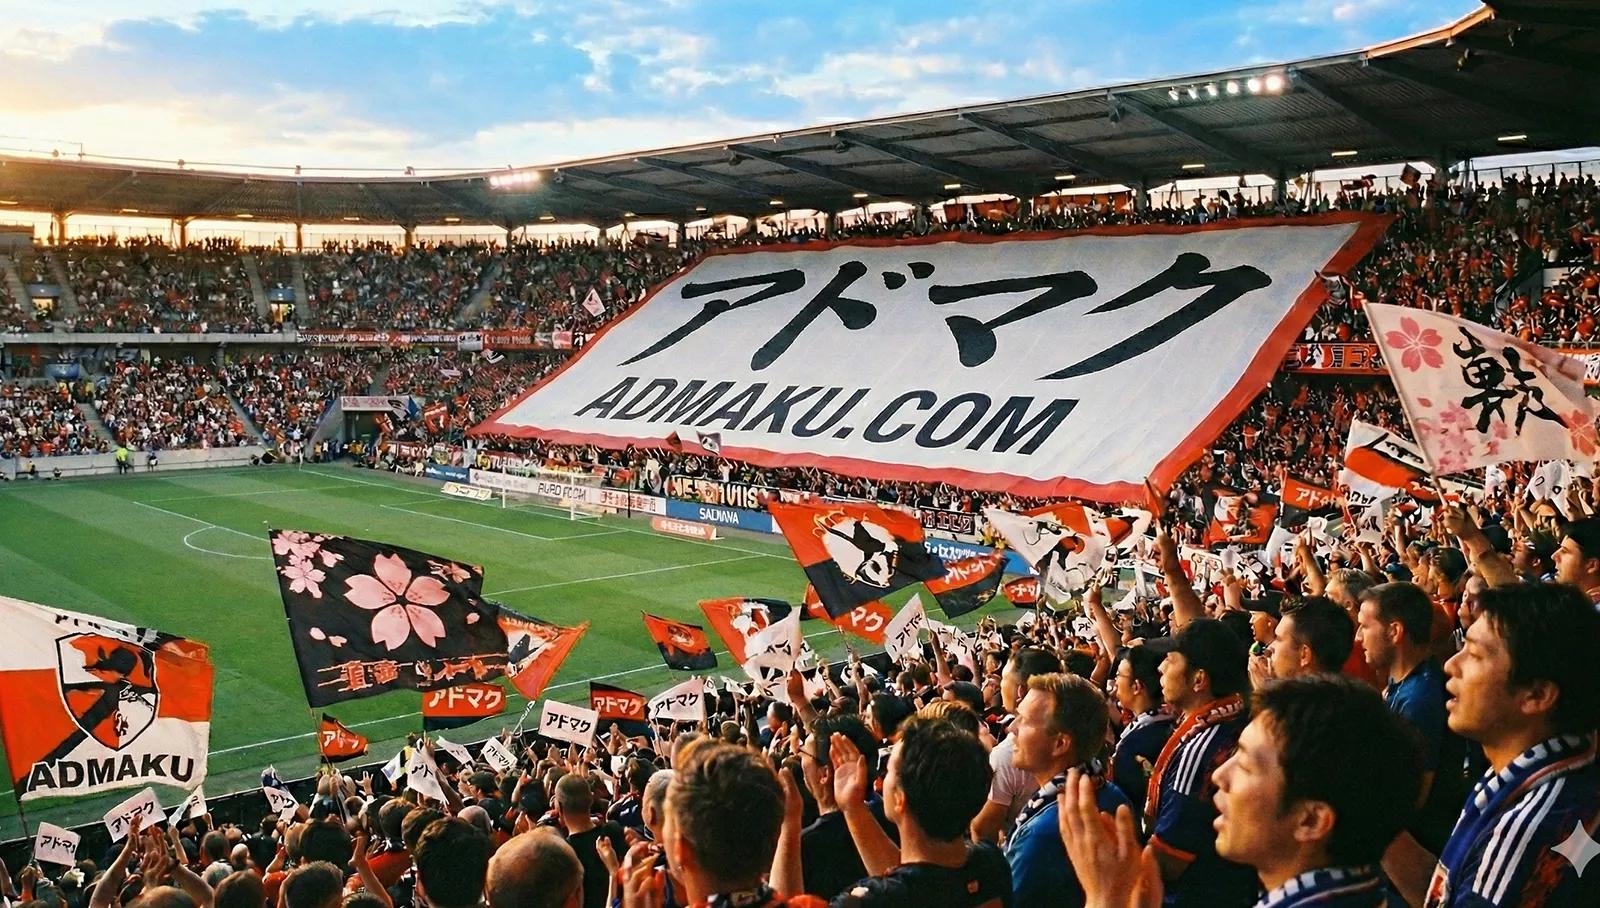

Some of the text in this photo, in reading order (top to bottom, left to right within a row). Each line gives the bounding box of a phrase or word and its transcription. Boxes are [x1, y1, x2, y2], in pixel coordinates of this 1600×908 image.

[617, 252, 1273, 381] アドマク
[574, 377, 1080, 455] ADMAKU.COM
[428, 687, 502, 710] アドマク
[593, 697, 642, 715] アドマク
[655, 693, 699, 715] アドマク
[547, 711, 591, 733] アドマク
[27, 754, 194, 791] ADMAKU
